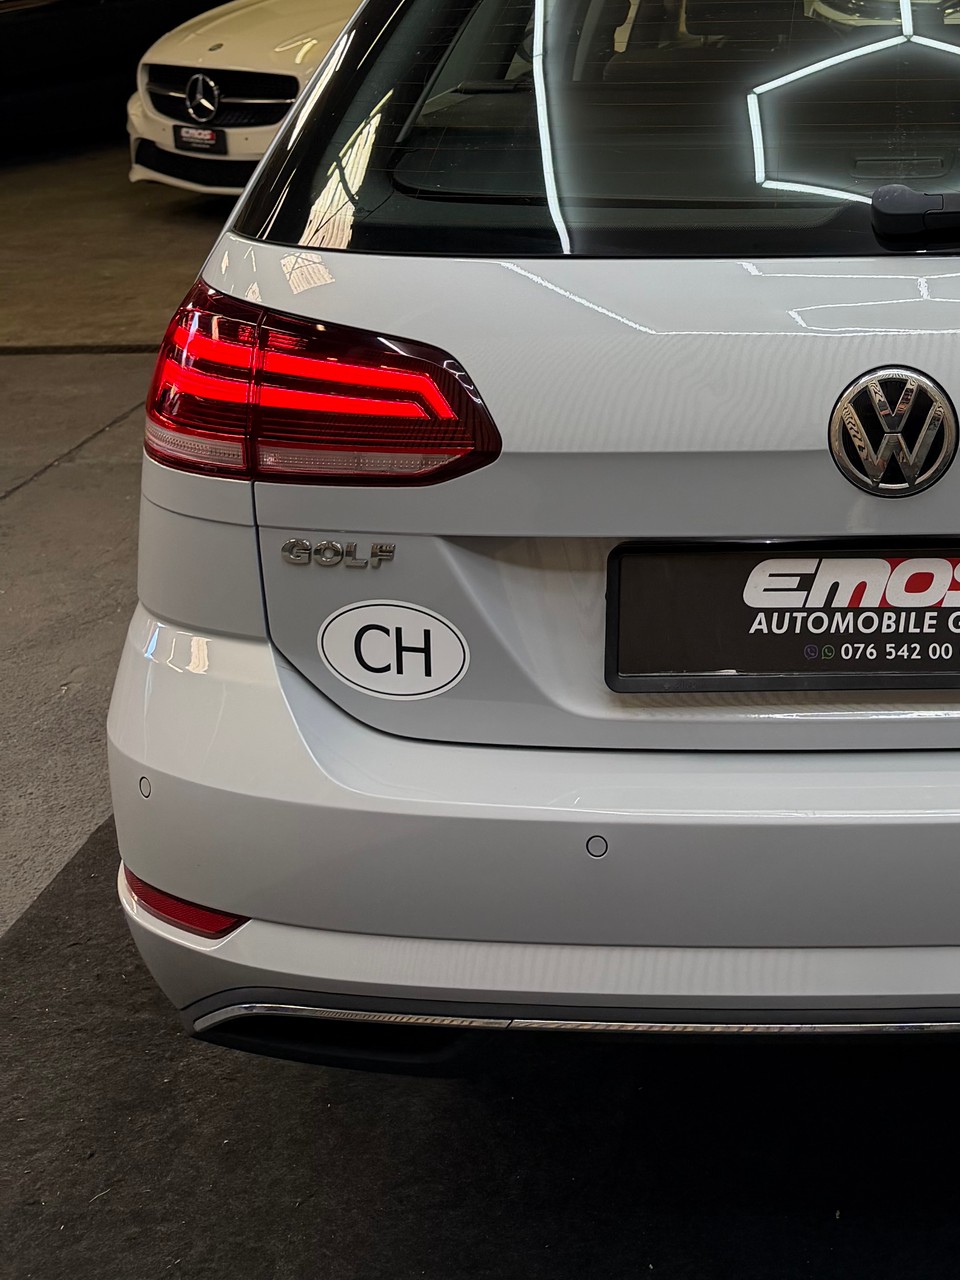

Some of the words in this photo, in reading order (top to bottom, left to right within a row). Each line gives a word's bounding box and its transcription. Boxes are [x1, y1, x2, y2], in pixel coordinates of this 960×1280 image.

[281, 537, 396, 570] GOLF
[748, 612, 938, 634] AUTOMOBILE
[354, 623, 433, 678] CH
[840, 643, 877, 660] 076
[885, 643, 922, 660] 542
[928, 643, 953, 660] 00
